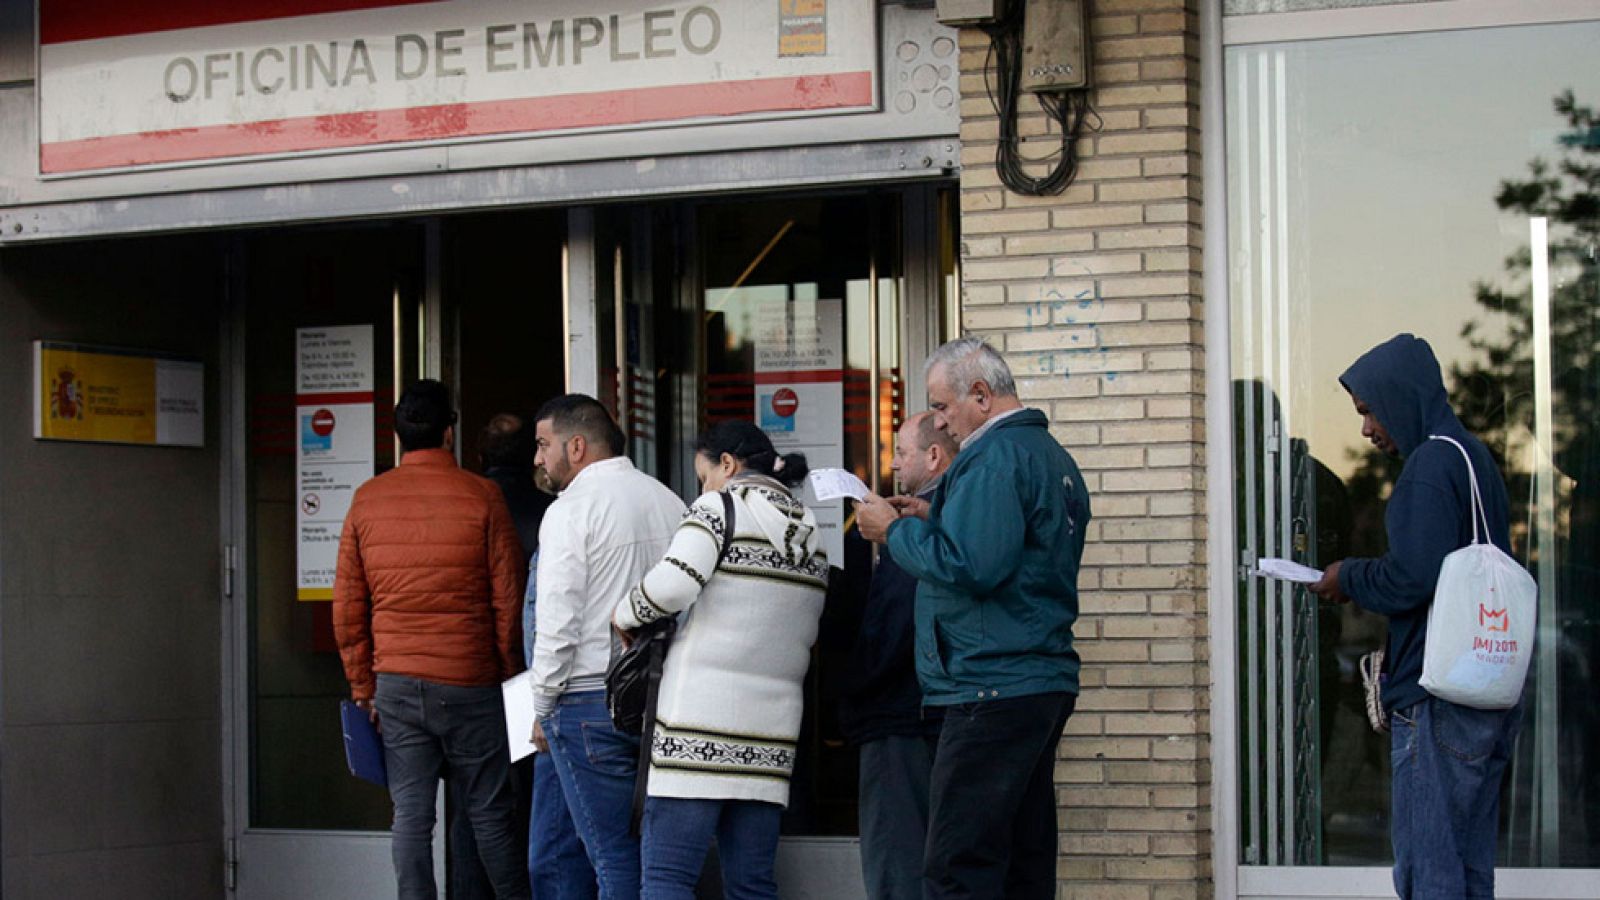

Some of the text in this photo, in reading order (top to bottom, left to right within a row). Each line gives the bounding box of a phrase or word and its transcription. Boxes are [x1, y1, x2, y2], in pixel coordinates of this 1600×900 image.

[163, 4, 722, 103] OFICINA DE EMPLEO
[1472, 636, 1493, 654] JMJ
